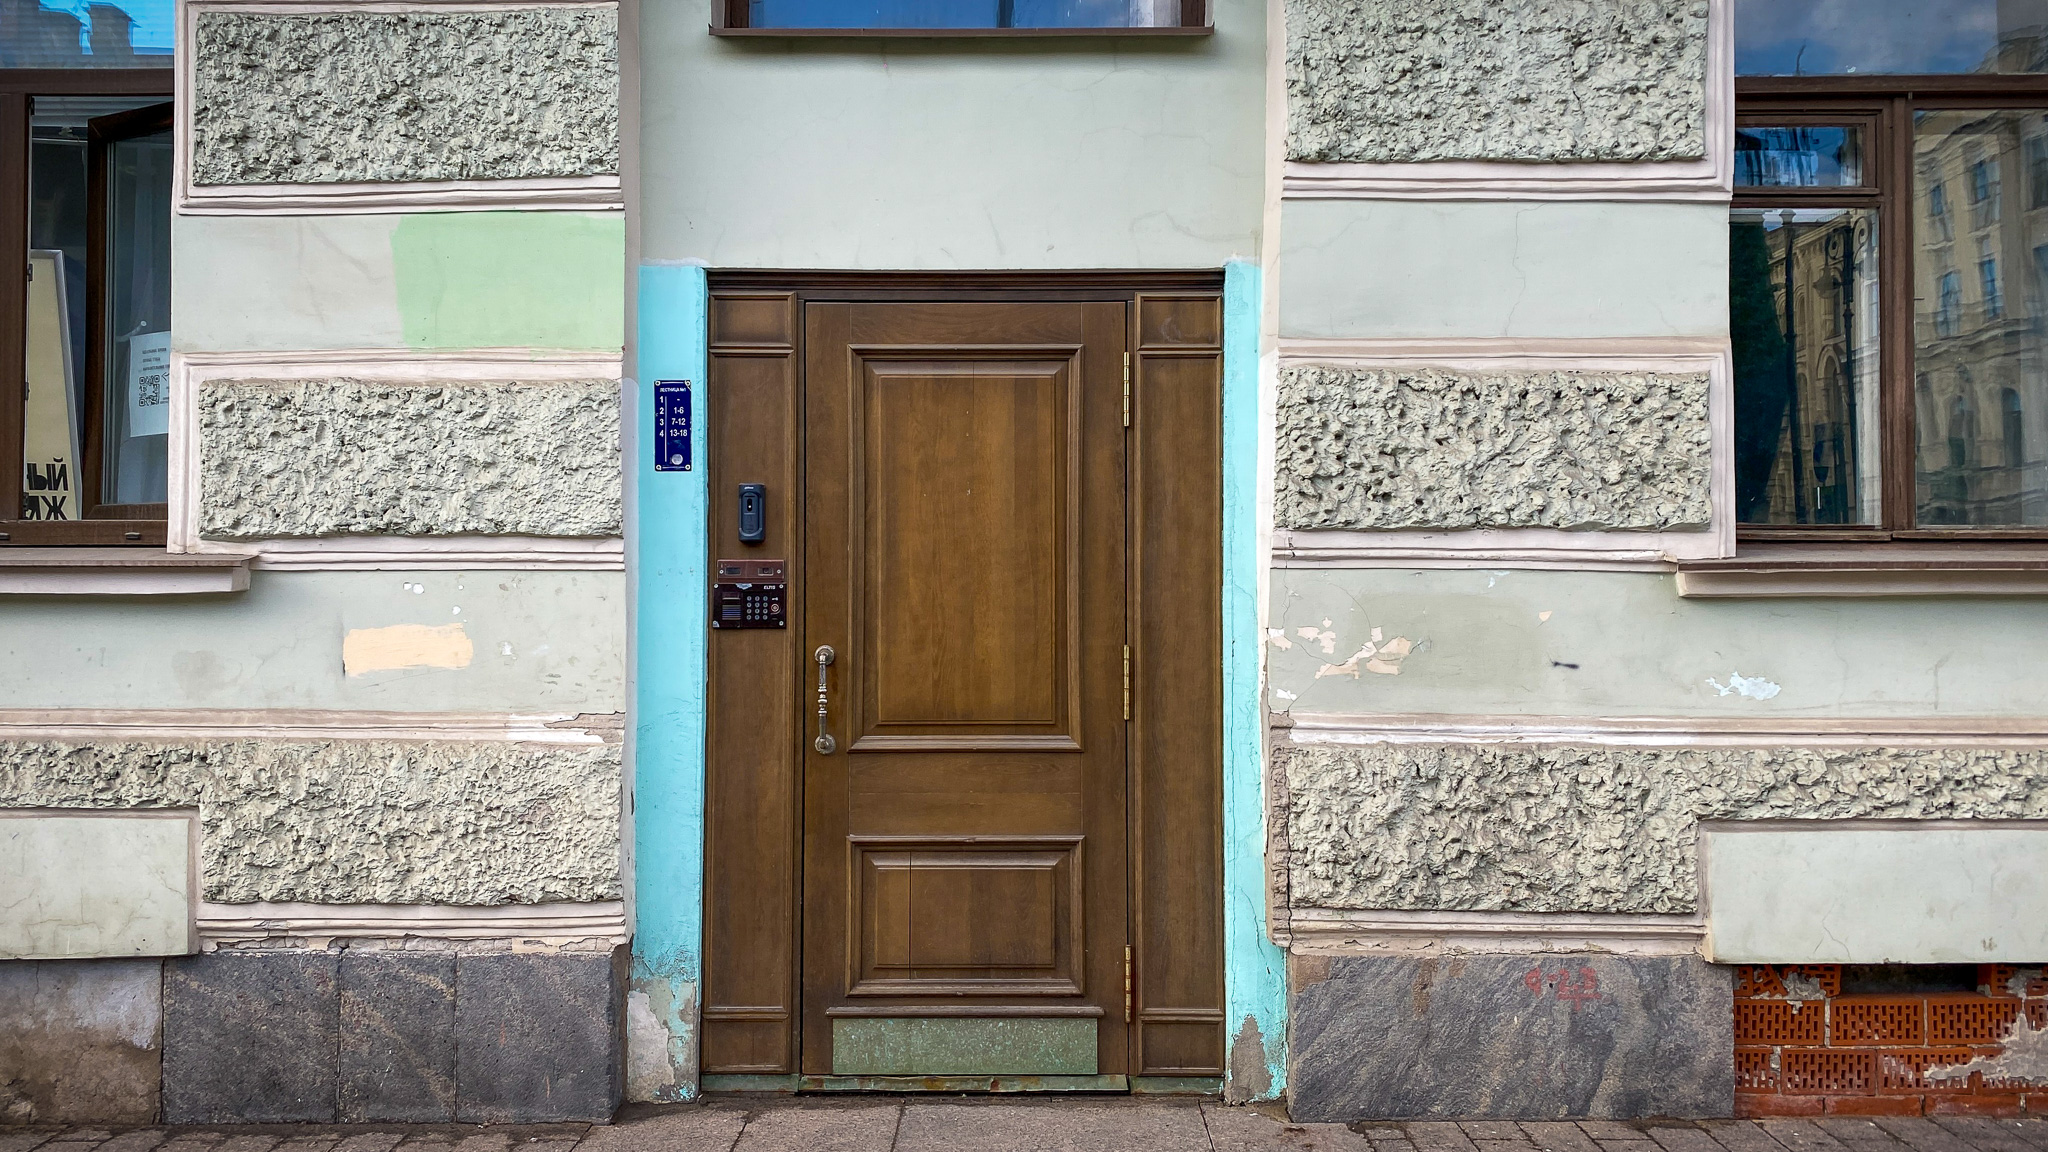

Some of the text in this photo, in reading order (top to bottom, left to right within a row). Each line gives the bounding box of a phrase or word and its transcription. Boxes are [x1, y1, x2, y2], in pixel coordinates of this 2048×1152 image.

[659, 406, 684, 415] 2 1-6
[659, 418, 664, 426] 3
[669, 429, 688, 437] 13-18
